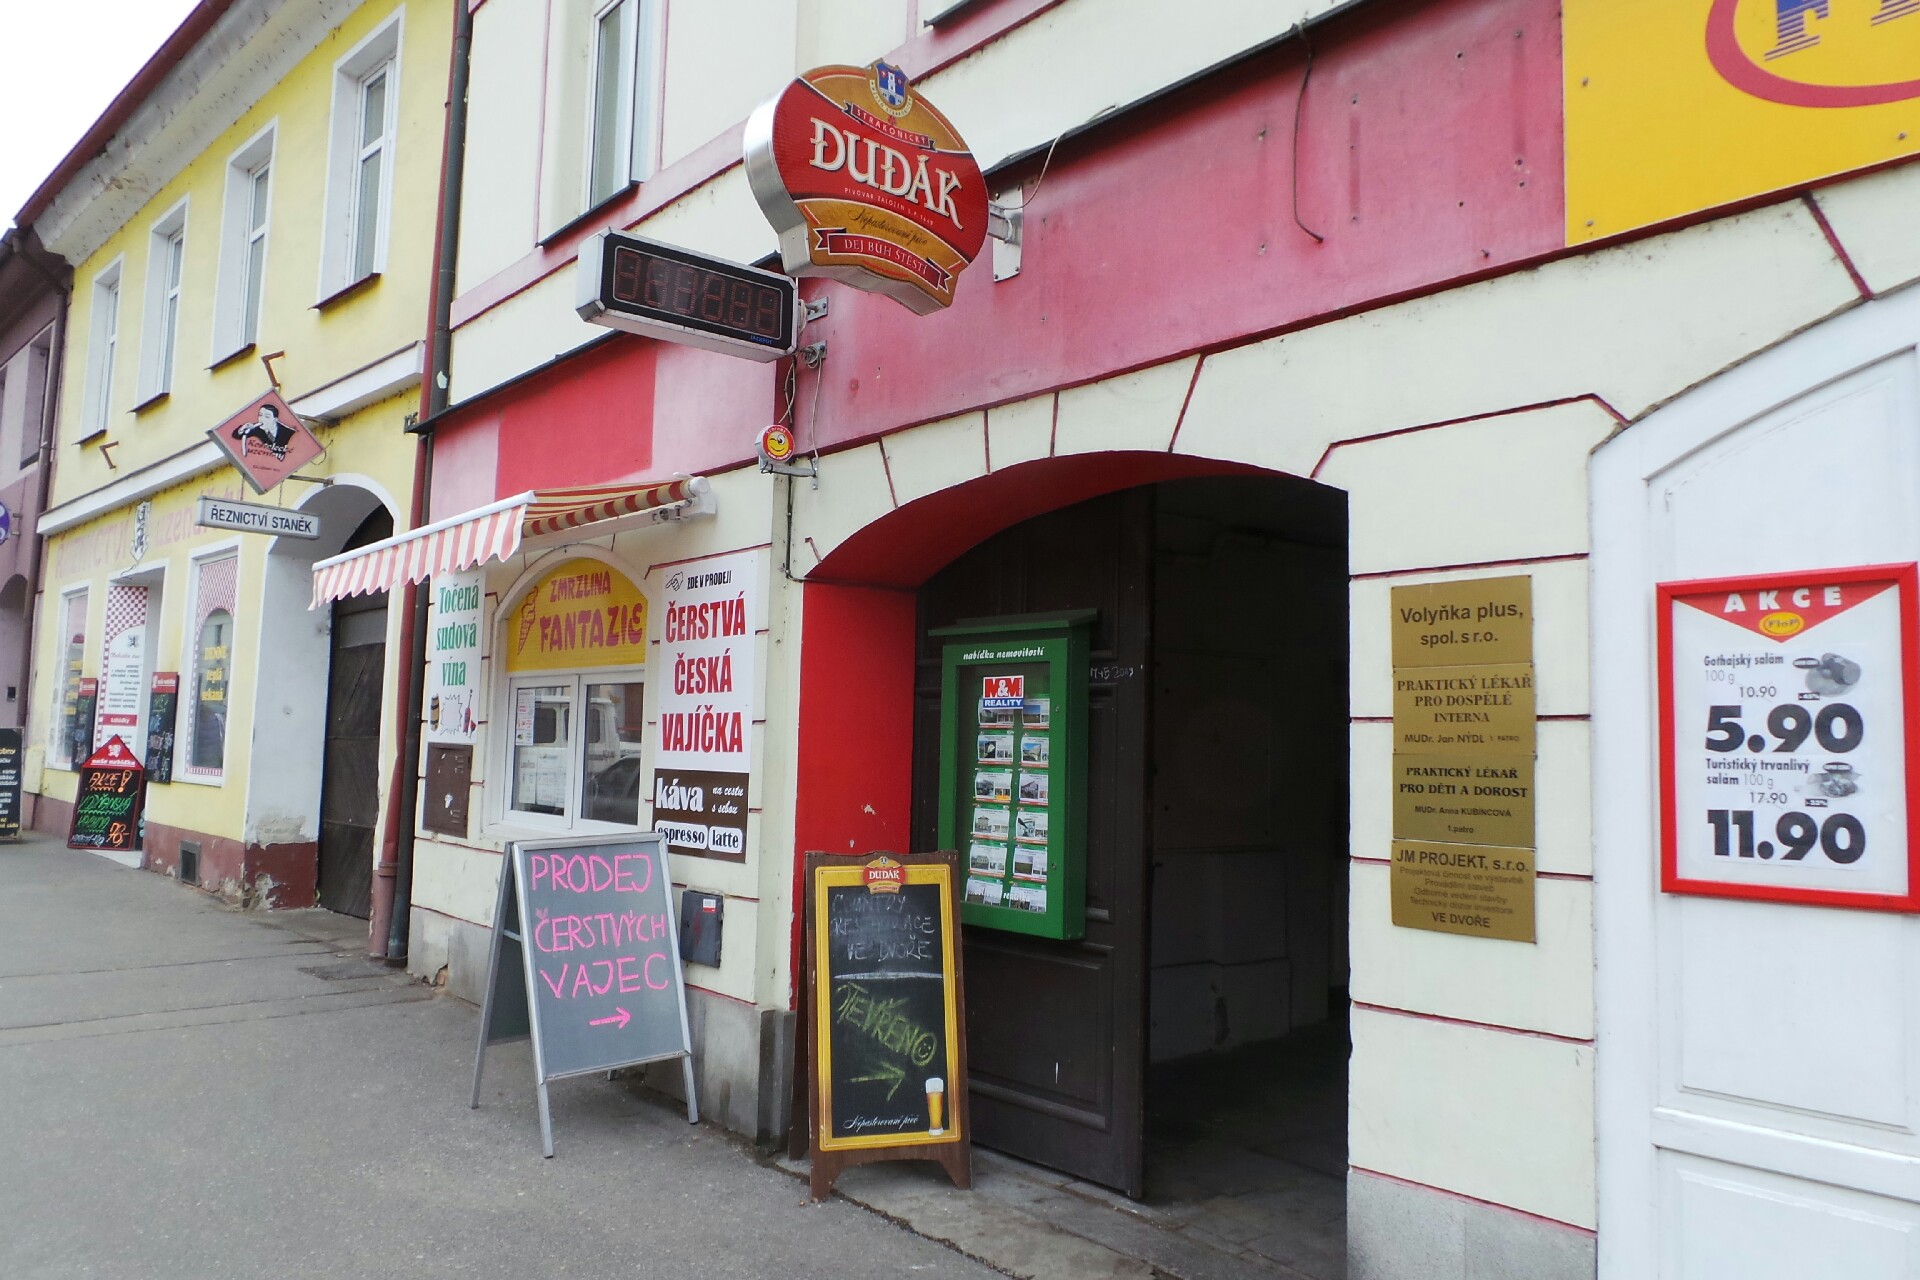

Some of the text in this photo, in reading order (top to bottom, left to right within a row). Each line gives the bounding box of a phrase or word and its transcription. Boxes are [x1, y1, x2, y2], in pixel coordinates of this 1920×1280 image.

[857, 109, 926, 144] STRAKONICKÝ
[844, 187, 875, 199] PIVOVAR
[844, 239, 864, 253] DEJ
[210, 504, 312, 534] ŘEZNICTVÍ STANĚK
[550, 570, 611, 603] ZMRZLINA
[687, 570, 732, 591] ZDE V PRODEJI
[439, 578, 480, 614] Točená
[1723, 586, 1843, 614] AKCE
[665, 590, 746, 643] ČERSTVÁ
[1400, 601, 1524, 626] Volyňka plus,
[436, 616, 477, 651] sudová
[540, 602, 643, 653] FANTAZIE
[1420, 630, 1458, 648] spol.
[963, 646, 1045, 660] nabídka nemovitostí
[1703, 653, 1752, 669] Gothajský
[1754, 652, 1784, 665] salám
[442, 656, 467, 686] vína
[674, 648, 732, 695] ČESKÁ
[1704, 669, 1735, 685] 100 g
[984, 678, 1020, 698] M&M
[1397, 673, 1533, 692] PRAKTICKÝ LÉKAŘ
[1739, 686, 1777, 698] 10.90
[984, 699, 1022, 707] REALITY
[1415, 690, 1513, 707] PRO DOSPĚLÉ
[1434, 712, 1490, 723] INTERNA
[662, 704, 743, 753] VAJÍČKA
[1705, 703, 1864, 753] 5.90
[1404, 734, 1434, 743] MUDr.
[1437, 734, 1454, 743] Jan
[1406, 766, 1518, 779] PRAKTICKÝ LÉKAŘ
[1705, 757, 1758, 773] Turistický
[1760, 757, 1811, 774] trvanlivý
[1399, 782, 1528, 798] PRO DĚTI A DOROST
[1706, 773, 1774, 790] salám 100 g
[655, 777, 744, 813] káva na cestu
[1749, 792, 1788, 804] 17.90
[718, 799, 738, 814] sebou
[1439, 807, 1459, 815] Anna
[712, 829, 739, 848] latte
[1707, 809, 1866, 864] 11.90
[1396, 849, 1530, 873] JM PROJEKT, s.r.o.
[531, 854, 653, 893] PRODEJ
[1431, 912, 1491, 928] VE DVOŘE
[534, 907, 666, 953] ČERSTVÝCH
[540, 953, 669, 999] VAJEC
